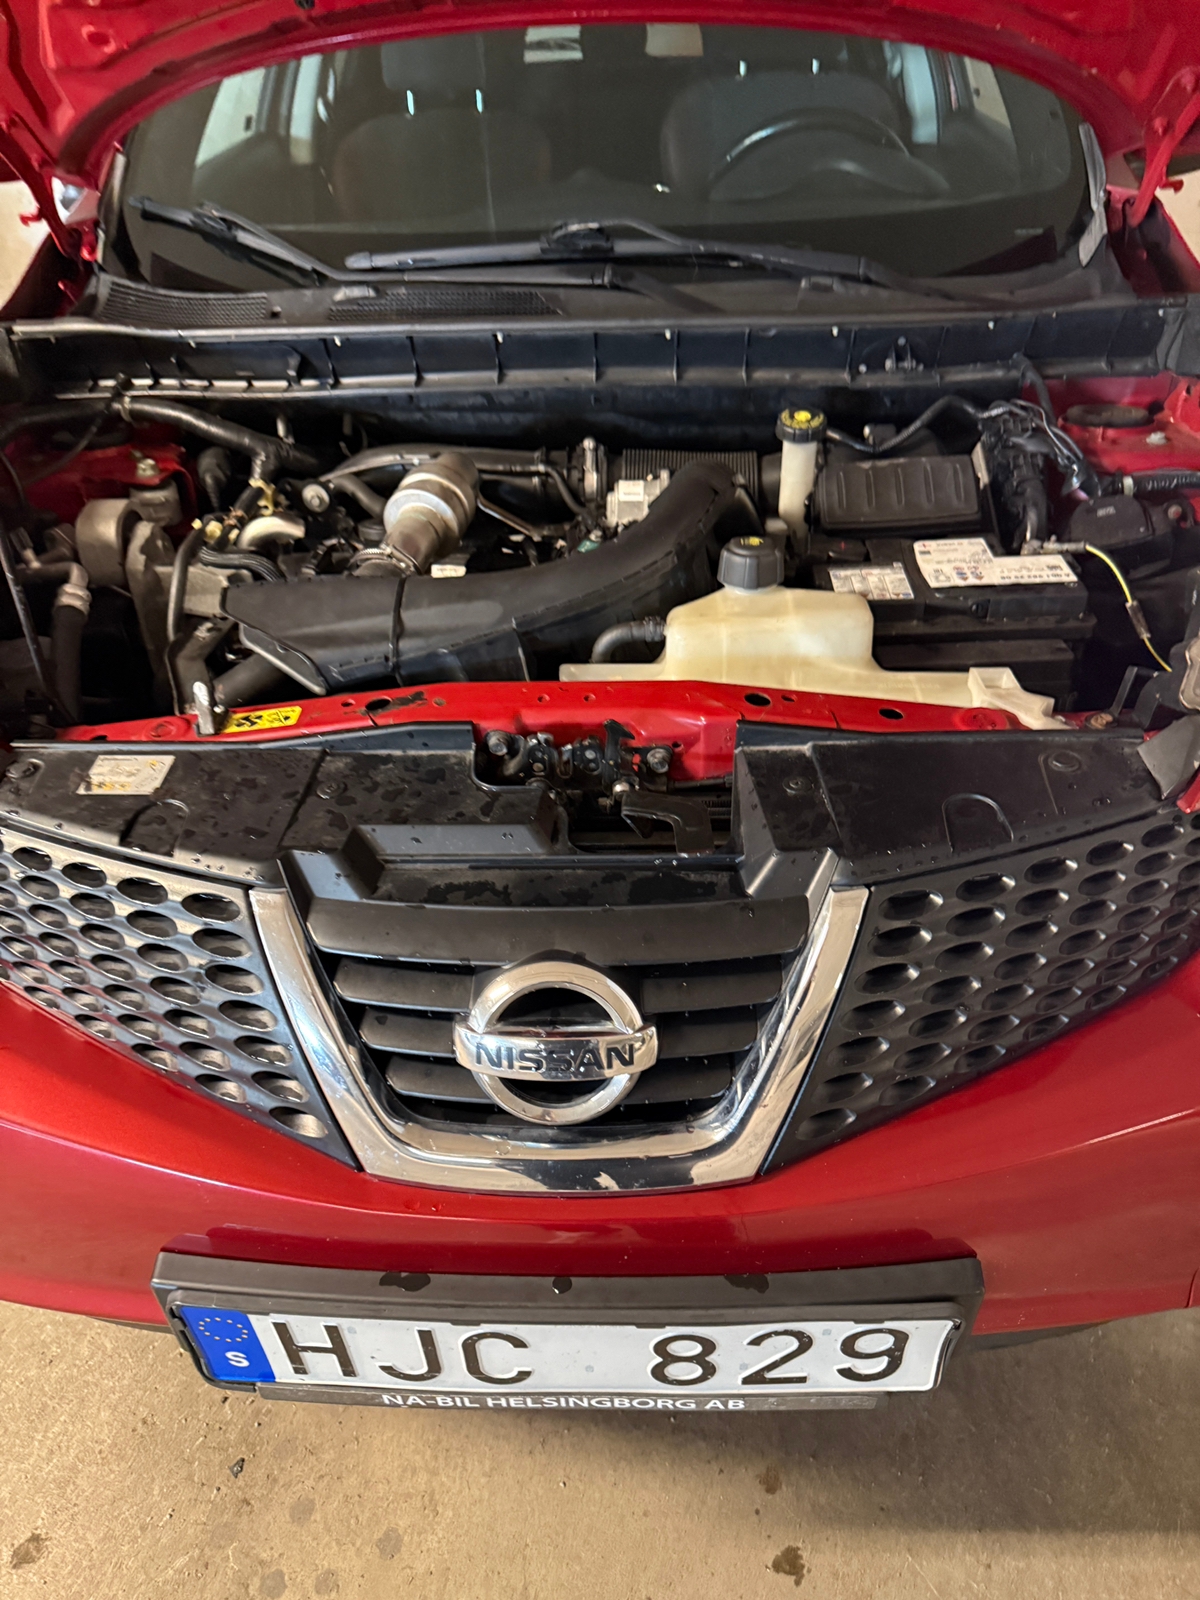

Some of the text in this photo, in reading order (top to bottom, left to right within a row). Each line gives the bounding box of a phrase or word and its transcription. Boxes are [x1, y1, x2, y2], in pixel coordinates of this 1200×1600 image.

[477, 1044, 635, 1072] NISSAN
[226, 1351, 250, 1368] S
[272, 1321, 909, 1386] HJC 829
[381, 1394, 746, 1410] NA-BIL HELSINGBORG AB
